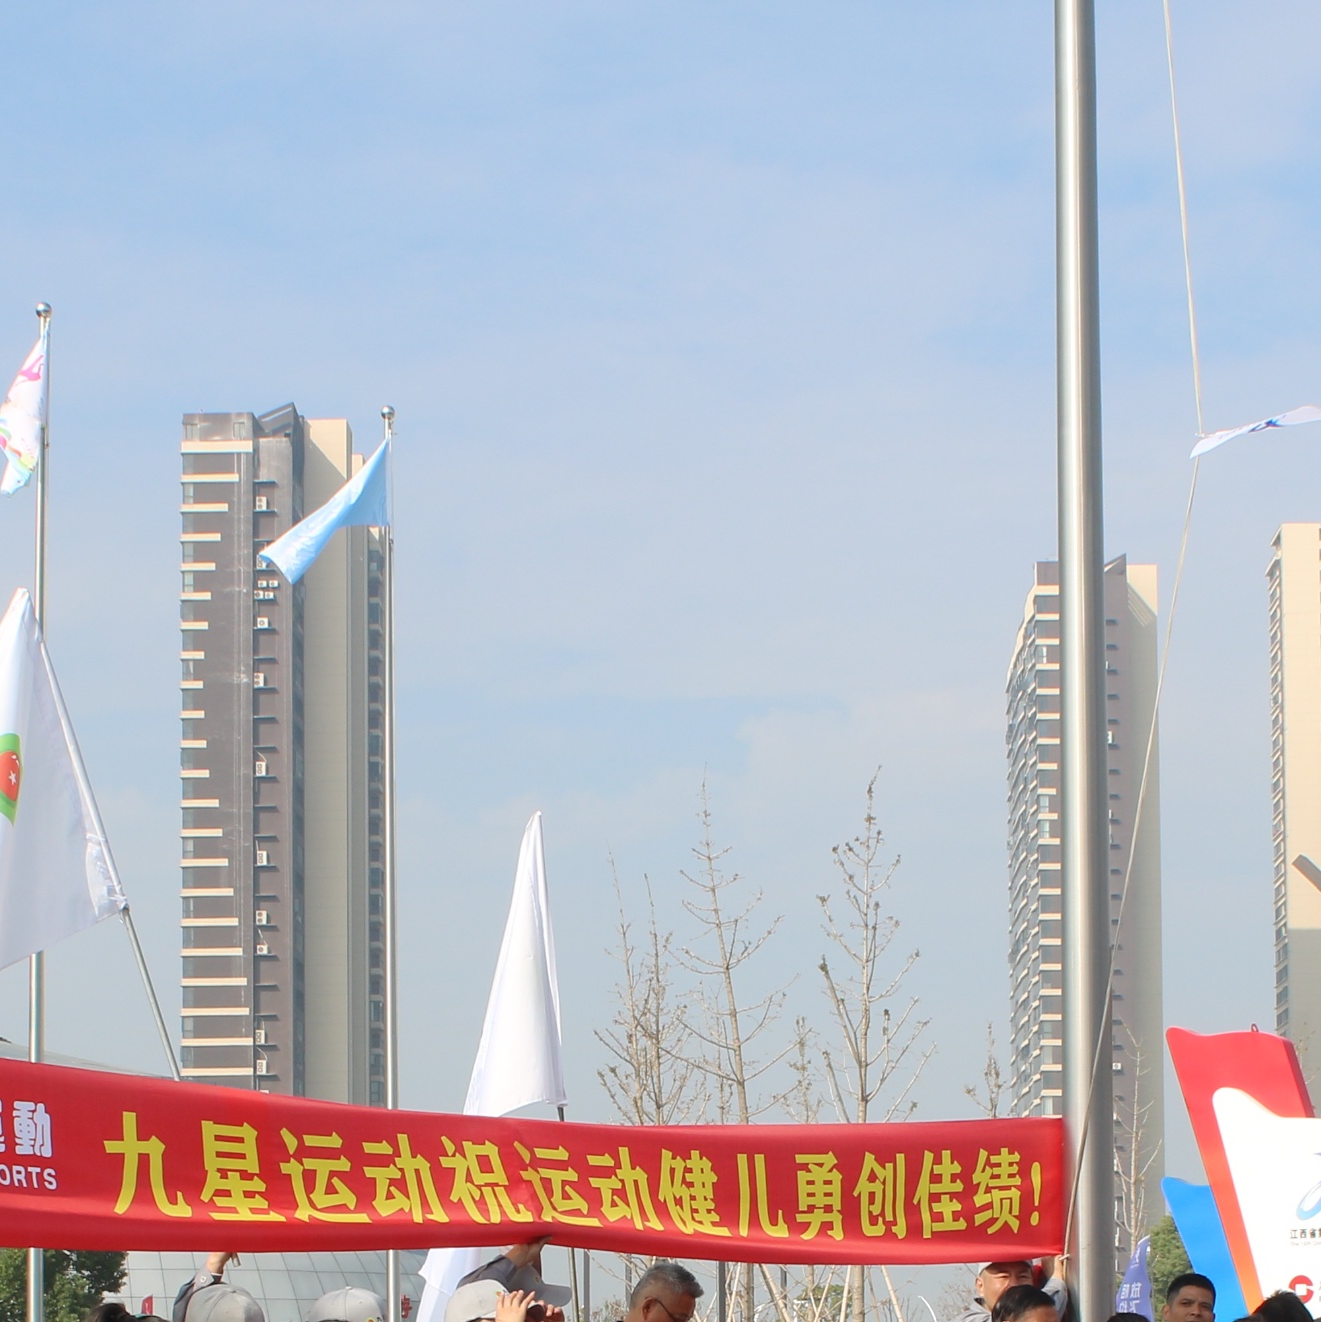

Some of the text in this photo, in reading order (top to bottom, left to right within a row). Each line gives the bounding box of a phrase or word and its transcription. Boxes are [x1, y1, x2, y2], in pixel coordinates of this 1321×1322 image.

[104, 1110, 1044, 1242] 九星运动祝运动健儿勇创佳绩!
